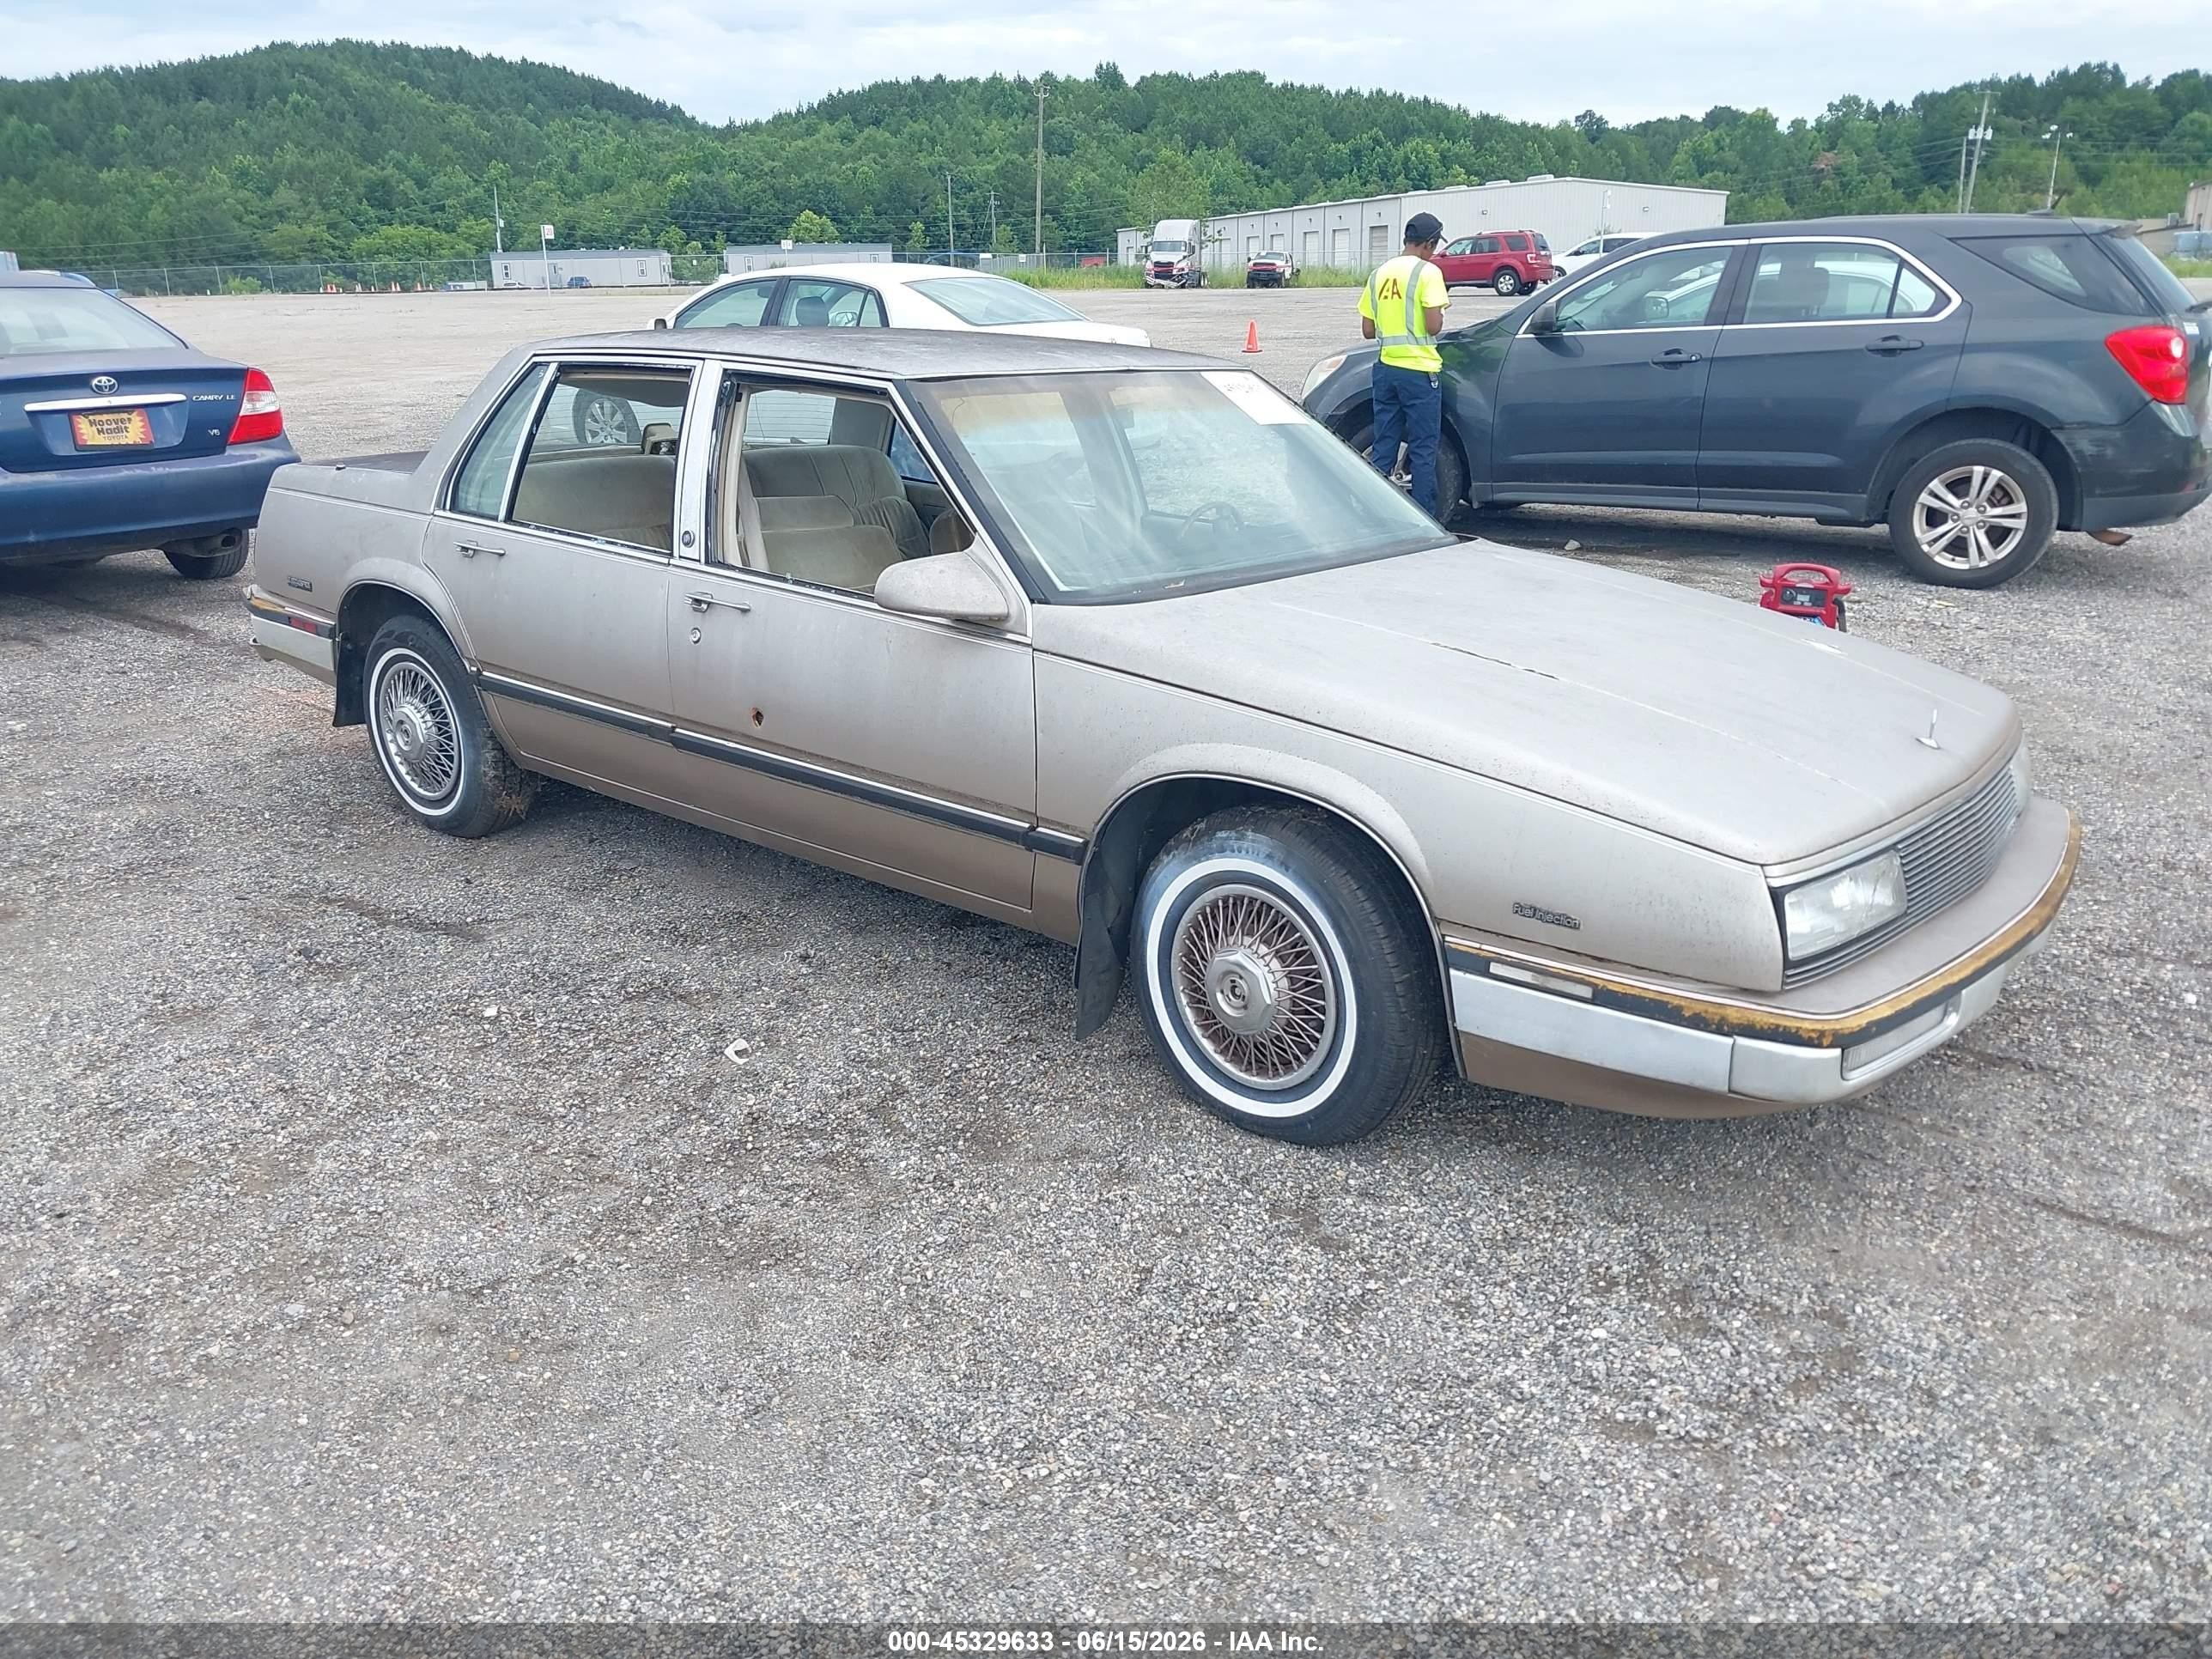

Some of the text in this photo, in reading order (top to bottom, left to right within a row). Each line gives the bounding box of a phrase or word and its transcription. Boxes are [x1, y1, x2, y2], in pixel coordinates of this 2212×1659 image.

[88, 417, 132, 428] Hoover
[1512, 902, 1581, 929] Fuel Injection
